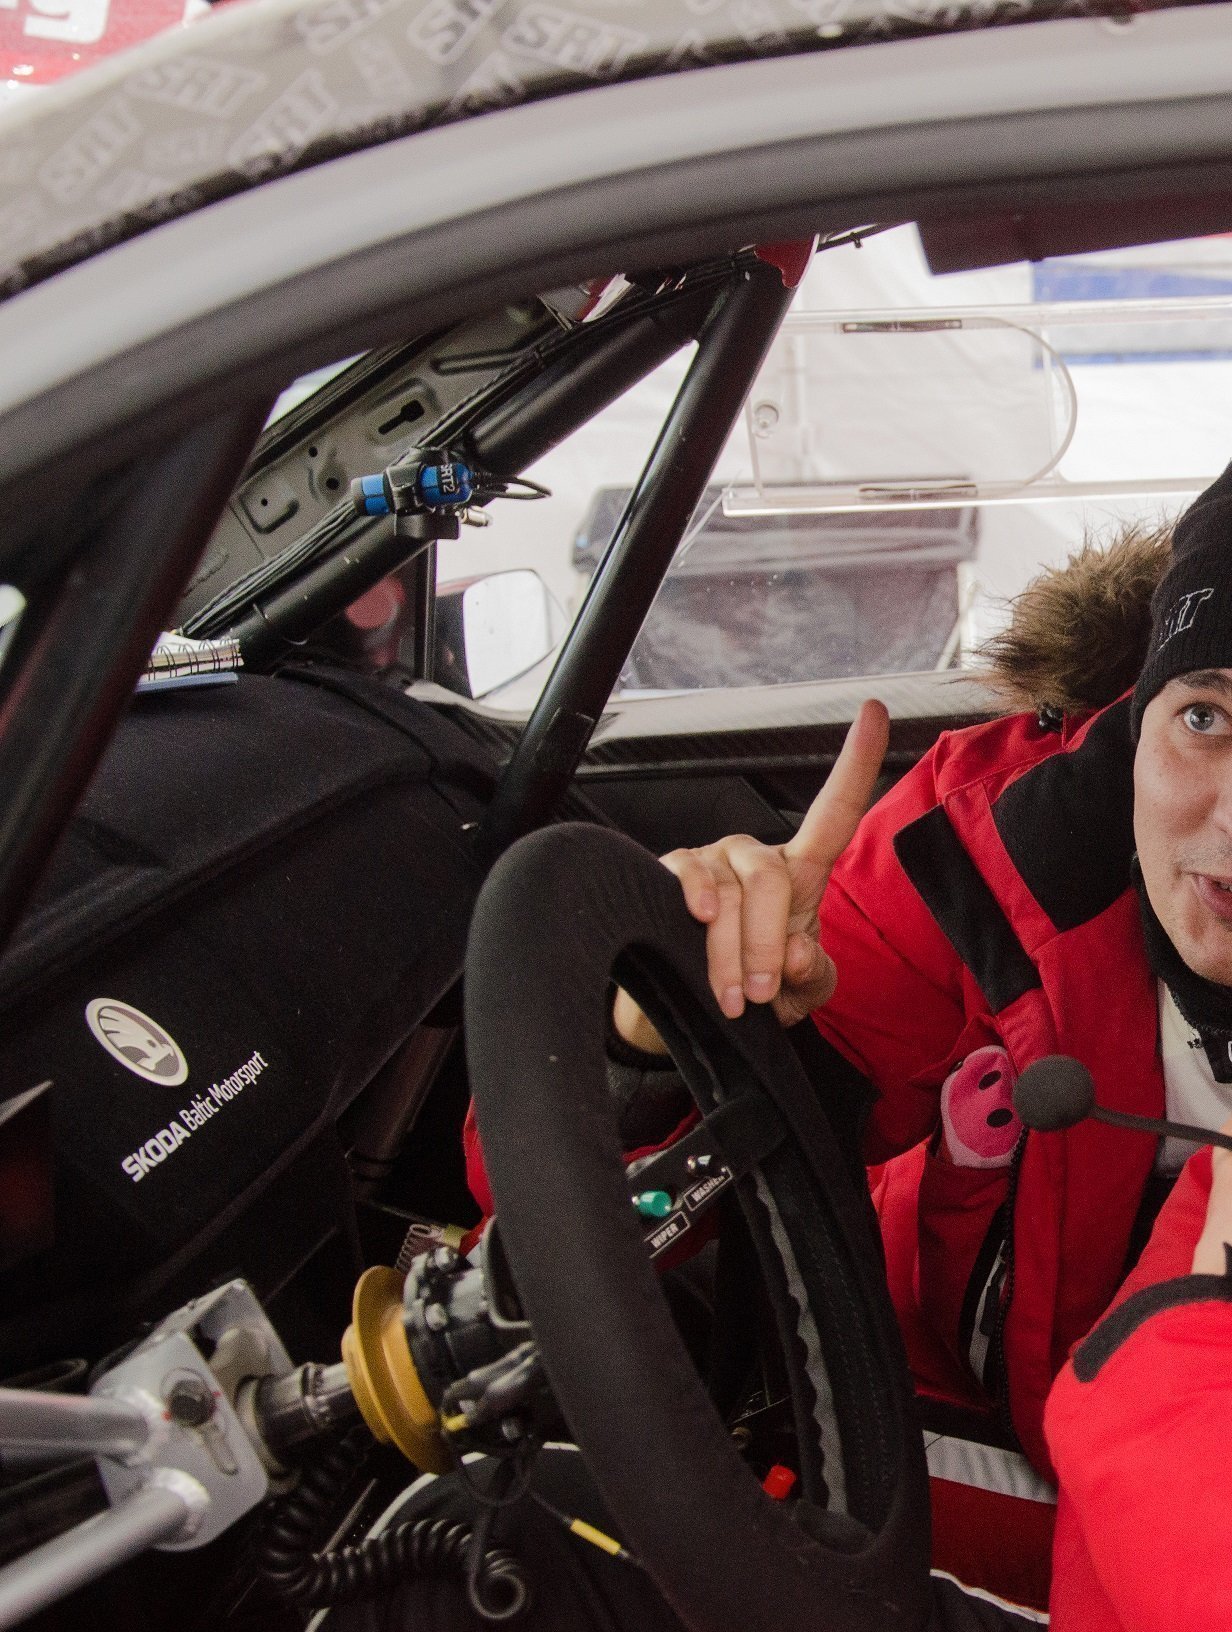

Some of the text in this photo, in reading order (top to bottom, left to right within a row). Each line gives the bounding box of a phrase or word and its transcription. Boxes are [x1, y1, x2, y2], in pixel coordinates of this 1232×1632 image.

[121, 1050, 269, 1183] SKODA Baltic Motorsport
[650, 1222, 680, 1250] WIPER
